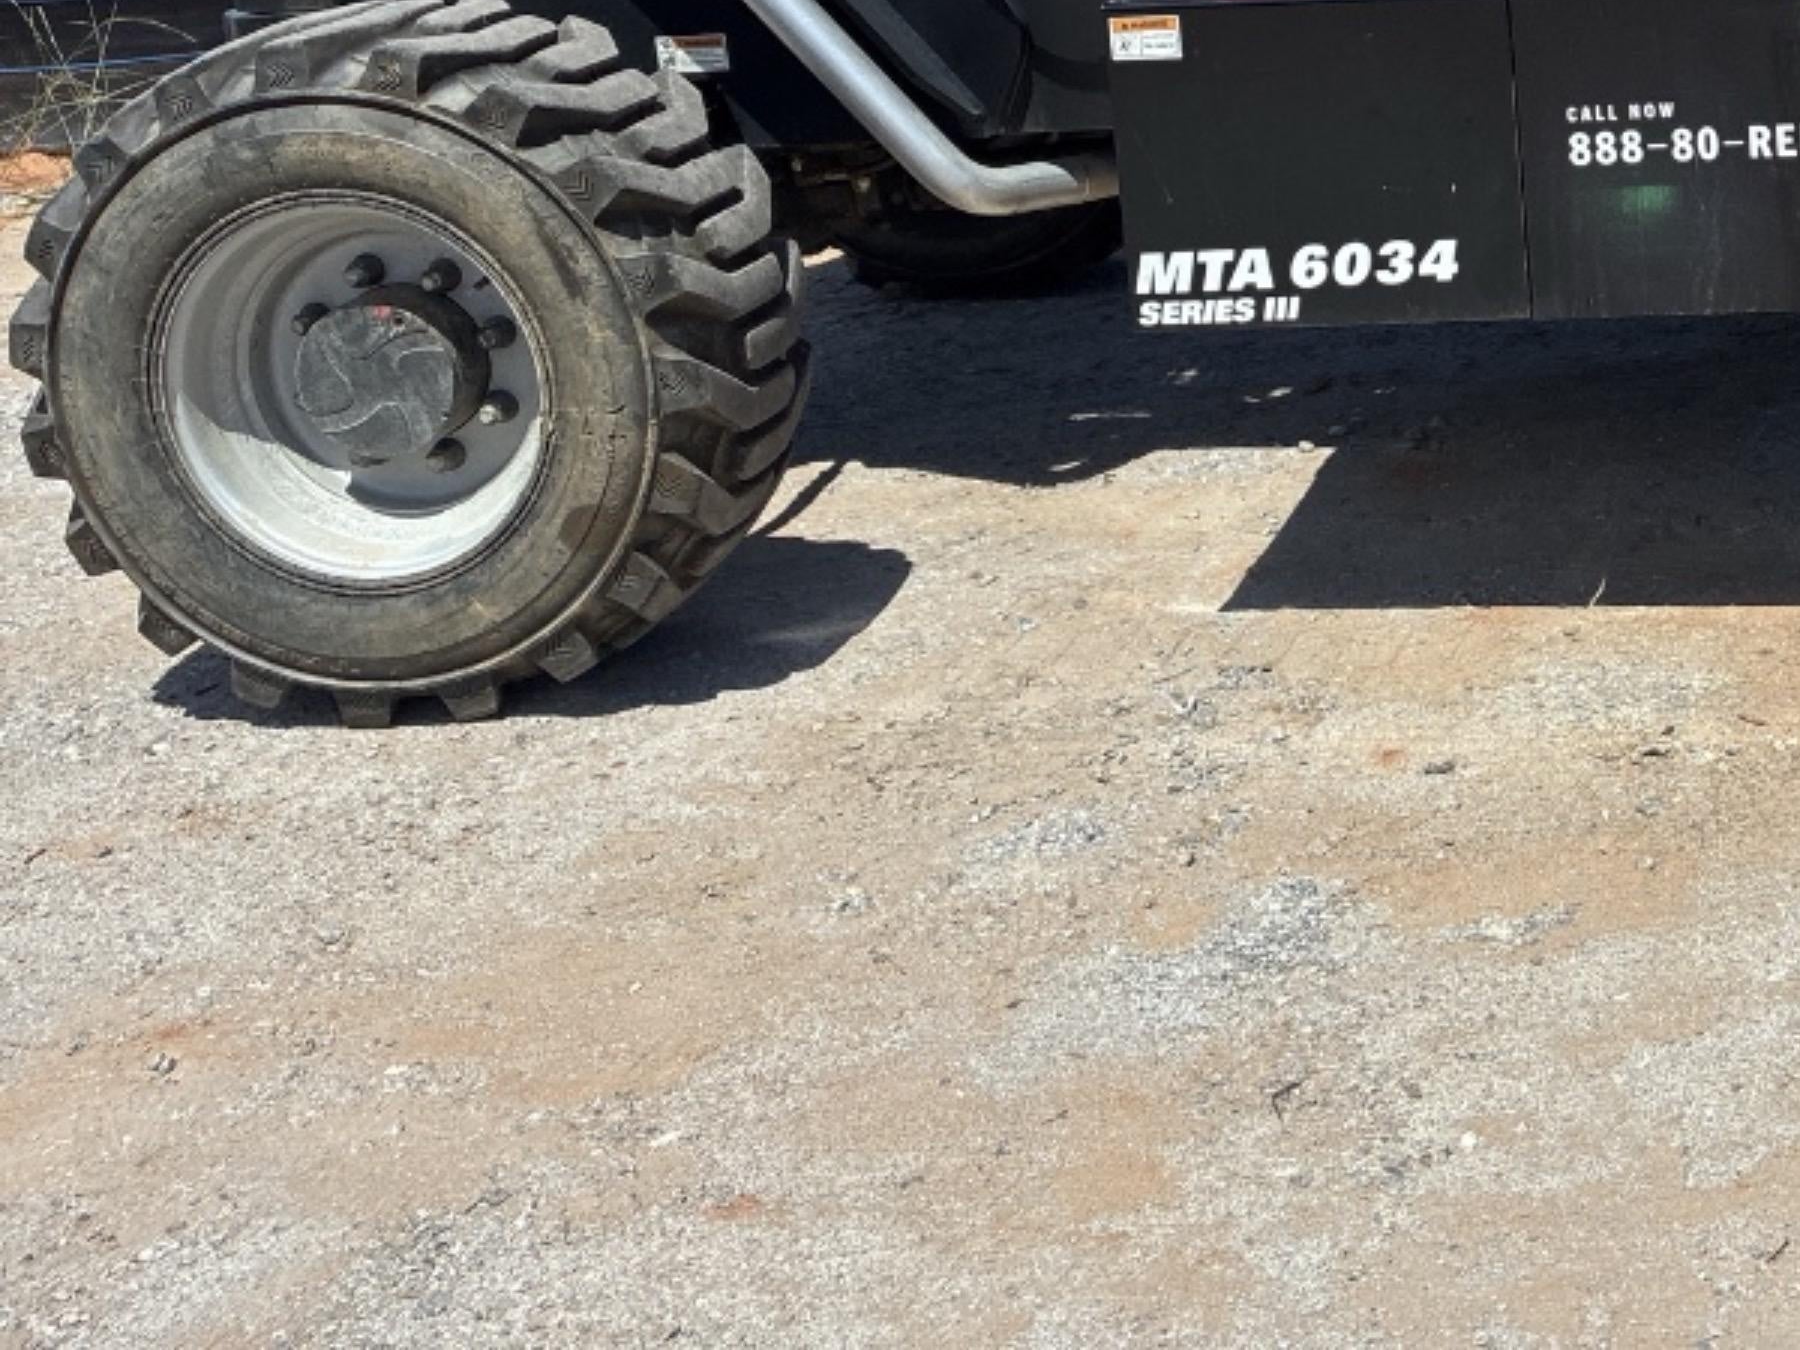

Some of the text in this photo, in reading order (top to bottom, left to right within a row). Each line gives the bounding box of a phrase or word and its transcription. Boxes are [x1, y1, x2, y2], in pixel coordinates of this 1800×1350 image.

[1565, 101, 1675, 123] CALL NOW
[1136, 239, 1460, 295] MTA 6034
[1138, 296, 1300, 326] SERIES III
